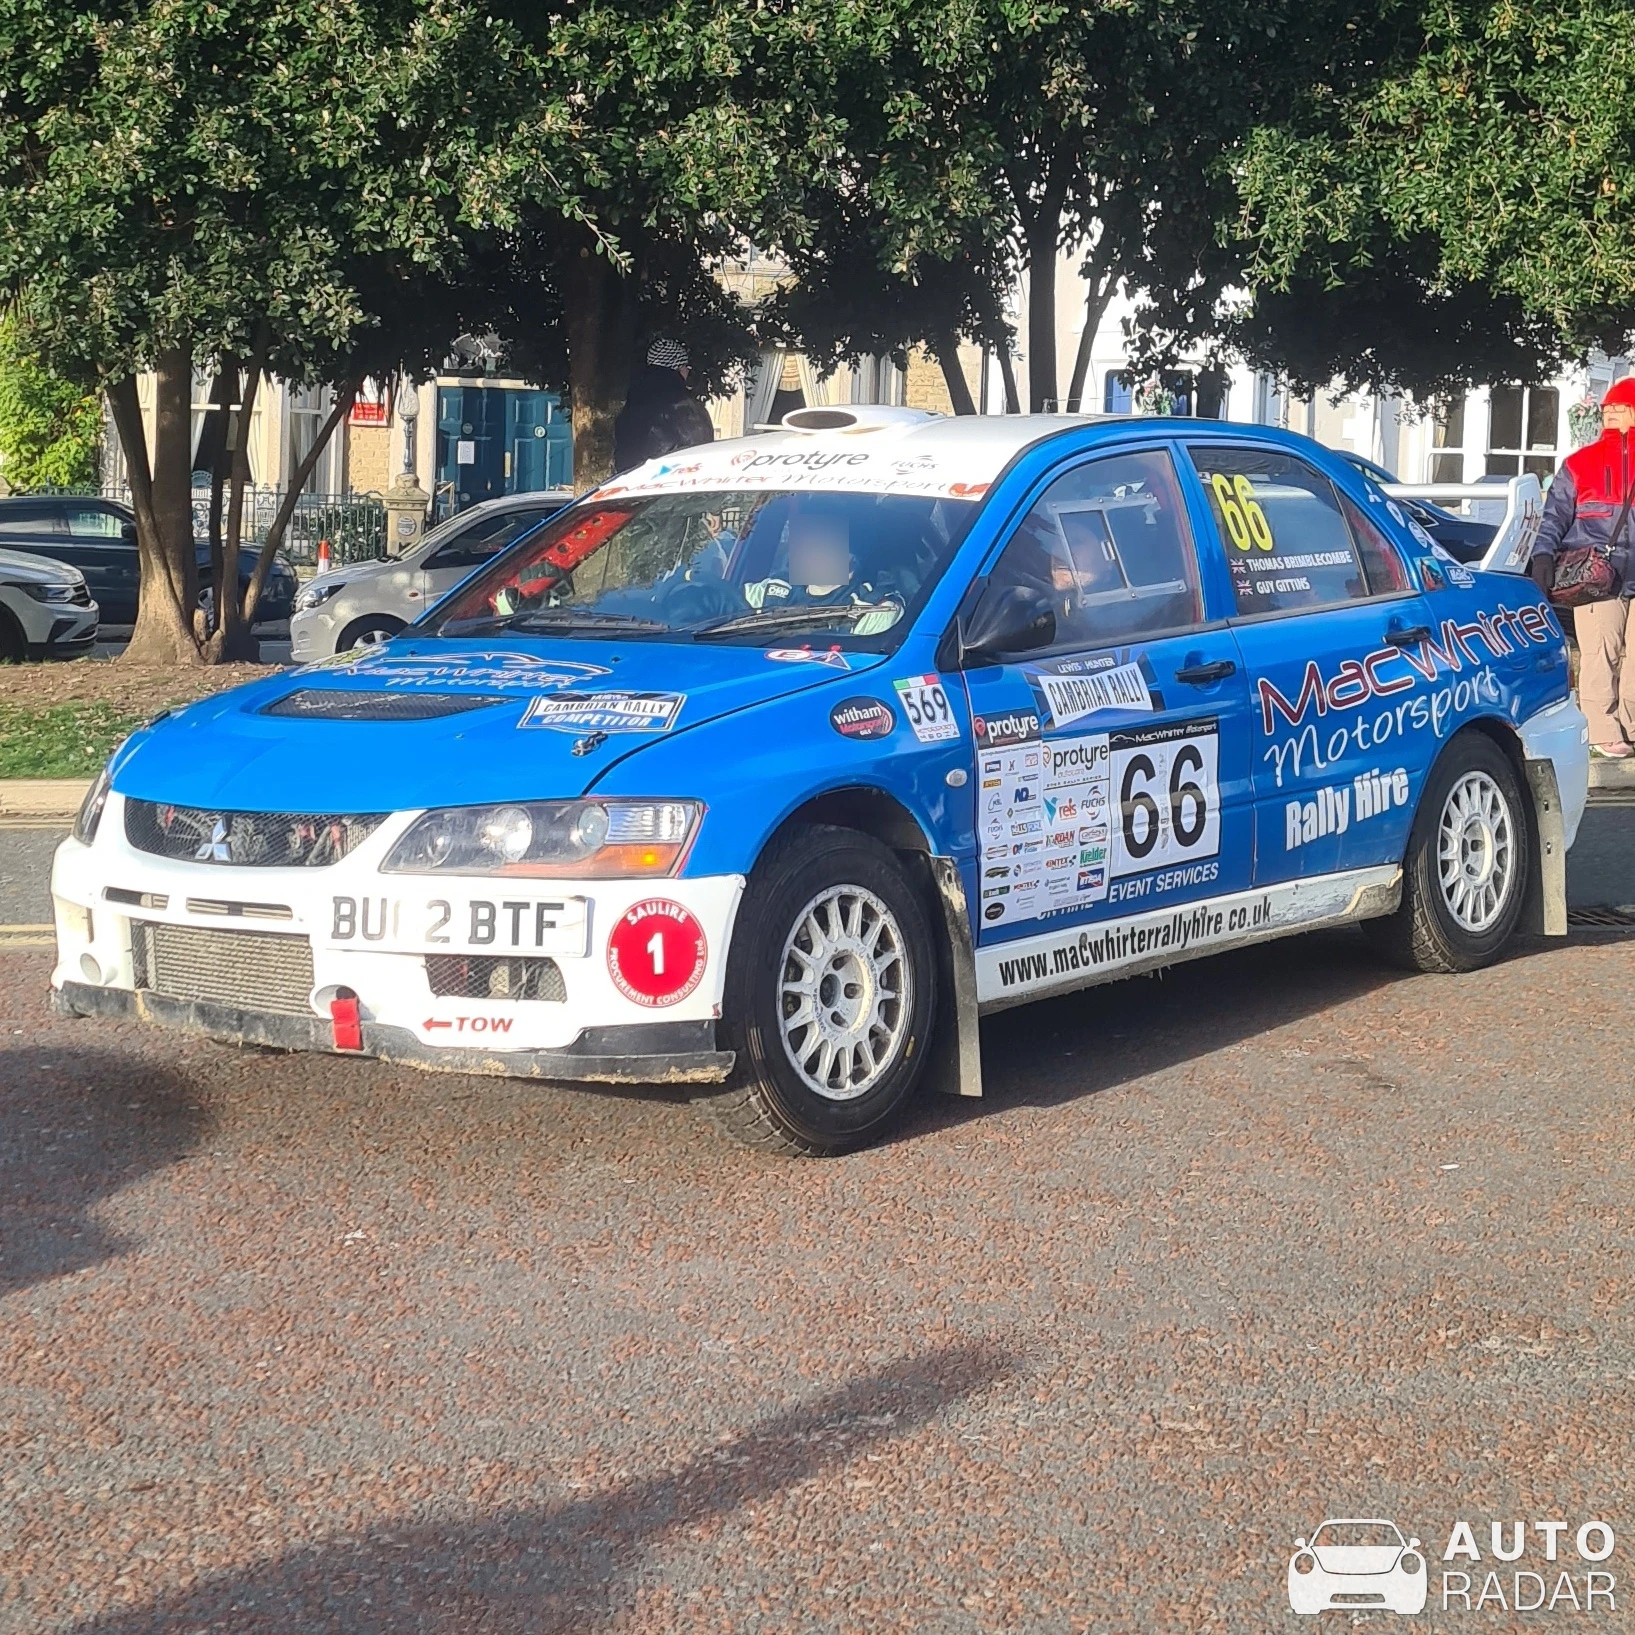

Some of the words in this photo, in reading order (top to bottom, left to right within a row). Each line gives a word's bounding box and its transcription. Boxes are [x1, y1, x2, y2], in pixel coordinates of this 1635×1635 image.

[742, 450, 869, 470] protyre
[782, 474, 946, 491] Motorsport
[1211, 473, 1273, 551] 66
[1246, 558, 1284, 572] THOMAS
[1284, 550, 1352, 569] BRIMBLECOMBE
[1256, 579, 1275, 594] GUY
[1275, 577, 1310, 592] GITTINS
[1057, 662, 1083, 674] LEWIS
[1084, 657, 1116, 670] HUNTER
[1258, 602, 1560, 736] MacWhirter
[902, 686, 949, 725] 569
[1047, 676, 1112, 716] CAMBRIAN
[1107, 668, 1146, 705] RALLY
[542, 713, 653, 727] COMPETITOR
[543, 701, 618, 712] CAMBRIAN
[623, 702, 667, 714] RALLY
[833, 706, 882, 725] witham
[986, 715, 1039, 744] protyre
[1135, 728, 1185, 743] MacWhirter
[1264, 665, 1500, 788] Motorsport
[1053, 744, 1109, 776] protyre
[1081, 796, 1106, 810] FUCHS
[1120, 743, 1208, 859] 66
[1286, 785, 1350, 851] Rally
[1354, 767, 1410, 822] Hire
[1109, 876, 1155, 904] EVENT
[1155, 862, 1220, 893] SERVICES
[468, 899, 566, 947] BTF
[626, 902, 688, 926] SAULIRE
[647, 932, 665, 976] 1
[609, 946, 655, 1005] PROCUREMENT
[656, 958, 704, 1005] CONSULTING
[455, 1016, 514, 1033] TOW
